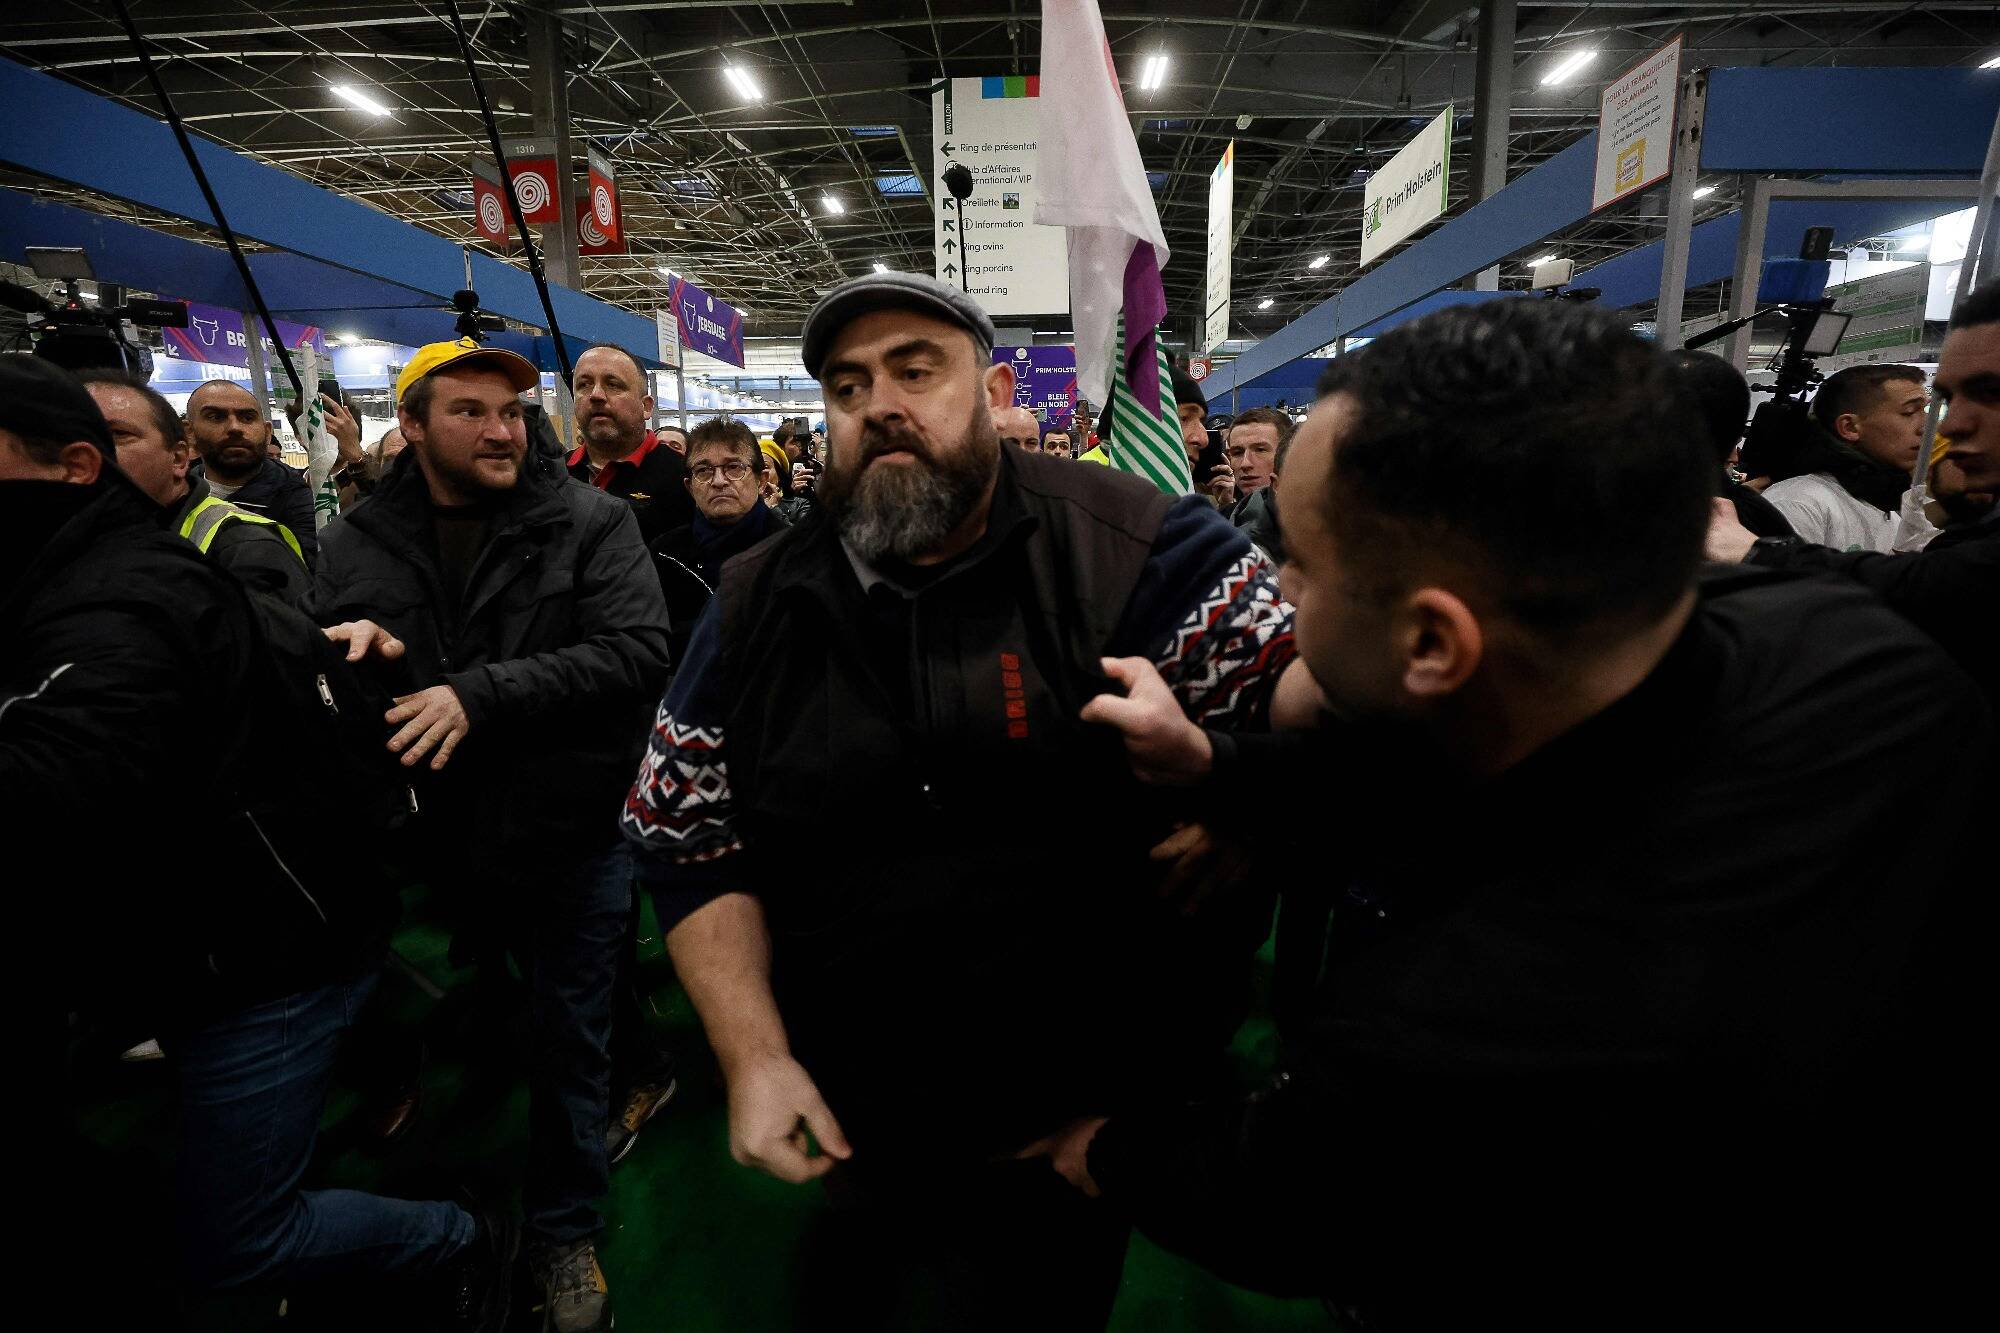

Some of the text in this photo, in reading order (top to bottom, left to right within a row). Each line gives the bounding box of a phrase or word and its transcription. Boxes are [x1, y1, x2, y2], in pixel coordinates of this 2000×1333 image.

[515, 145, 535, 154] 1310
[961, 141, 1037, 154] Ring de présentati
[982, 165, 1021, 174] d'Affaires
[971, 175, 1013, 184] ernational
[1386, 160, 1442, 215] Prim'Holstein
[961, 199, 1000, 207] Oreillette
[975, 220, 1024, 229] Information
[962, 242, 1004, 252] Ring ovins
[963, 264, 1014, 274] Ring porcins
[965, 285, 1008, 295] Grand ring
